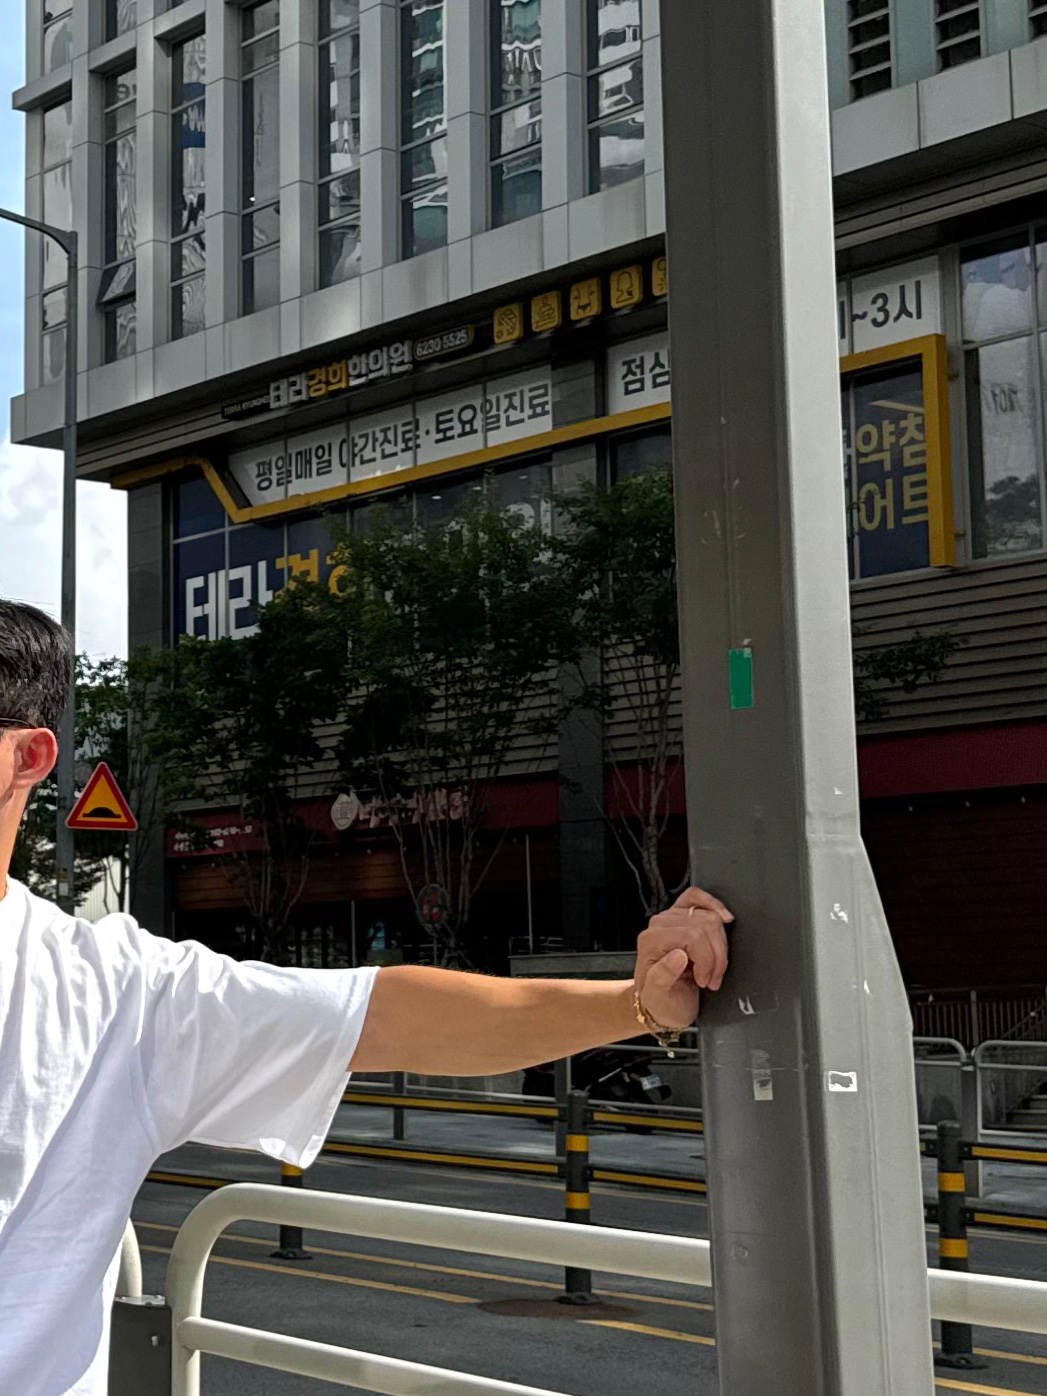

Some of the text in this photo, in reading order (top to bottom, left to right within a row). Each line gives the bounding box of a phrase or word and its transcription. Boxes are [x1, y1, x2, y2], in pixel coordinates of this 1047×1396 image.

[416, 328, 468, 356] 6230 5525
[269, 340, 413, 409] 테라경희한의원
[256, 444, 333, 492] 평일매일
